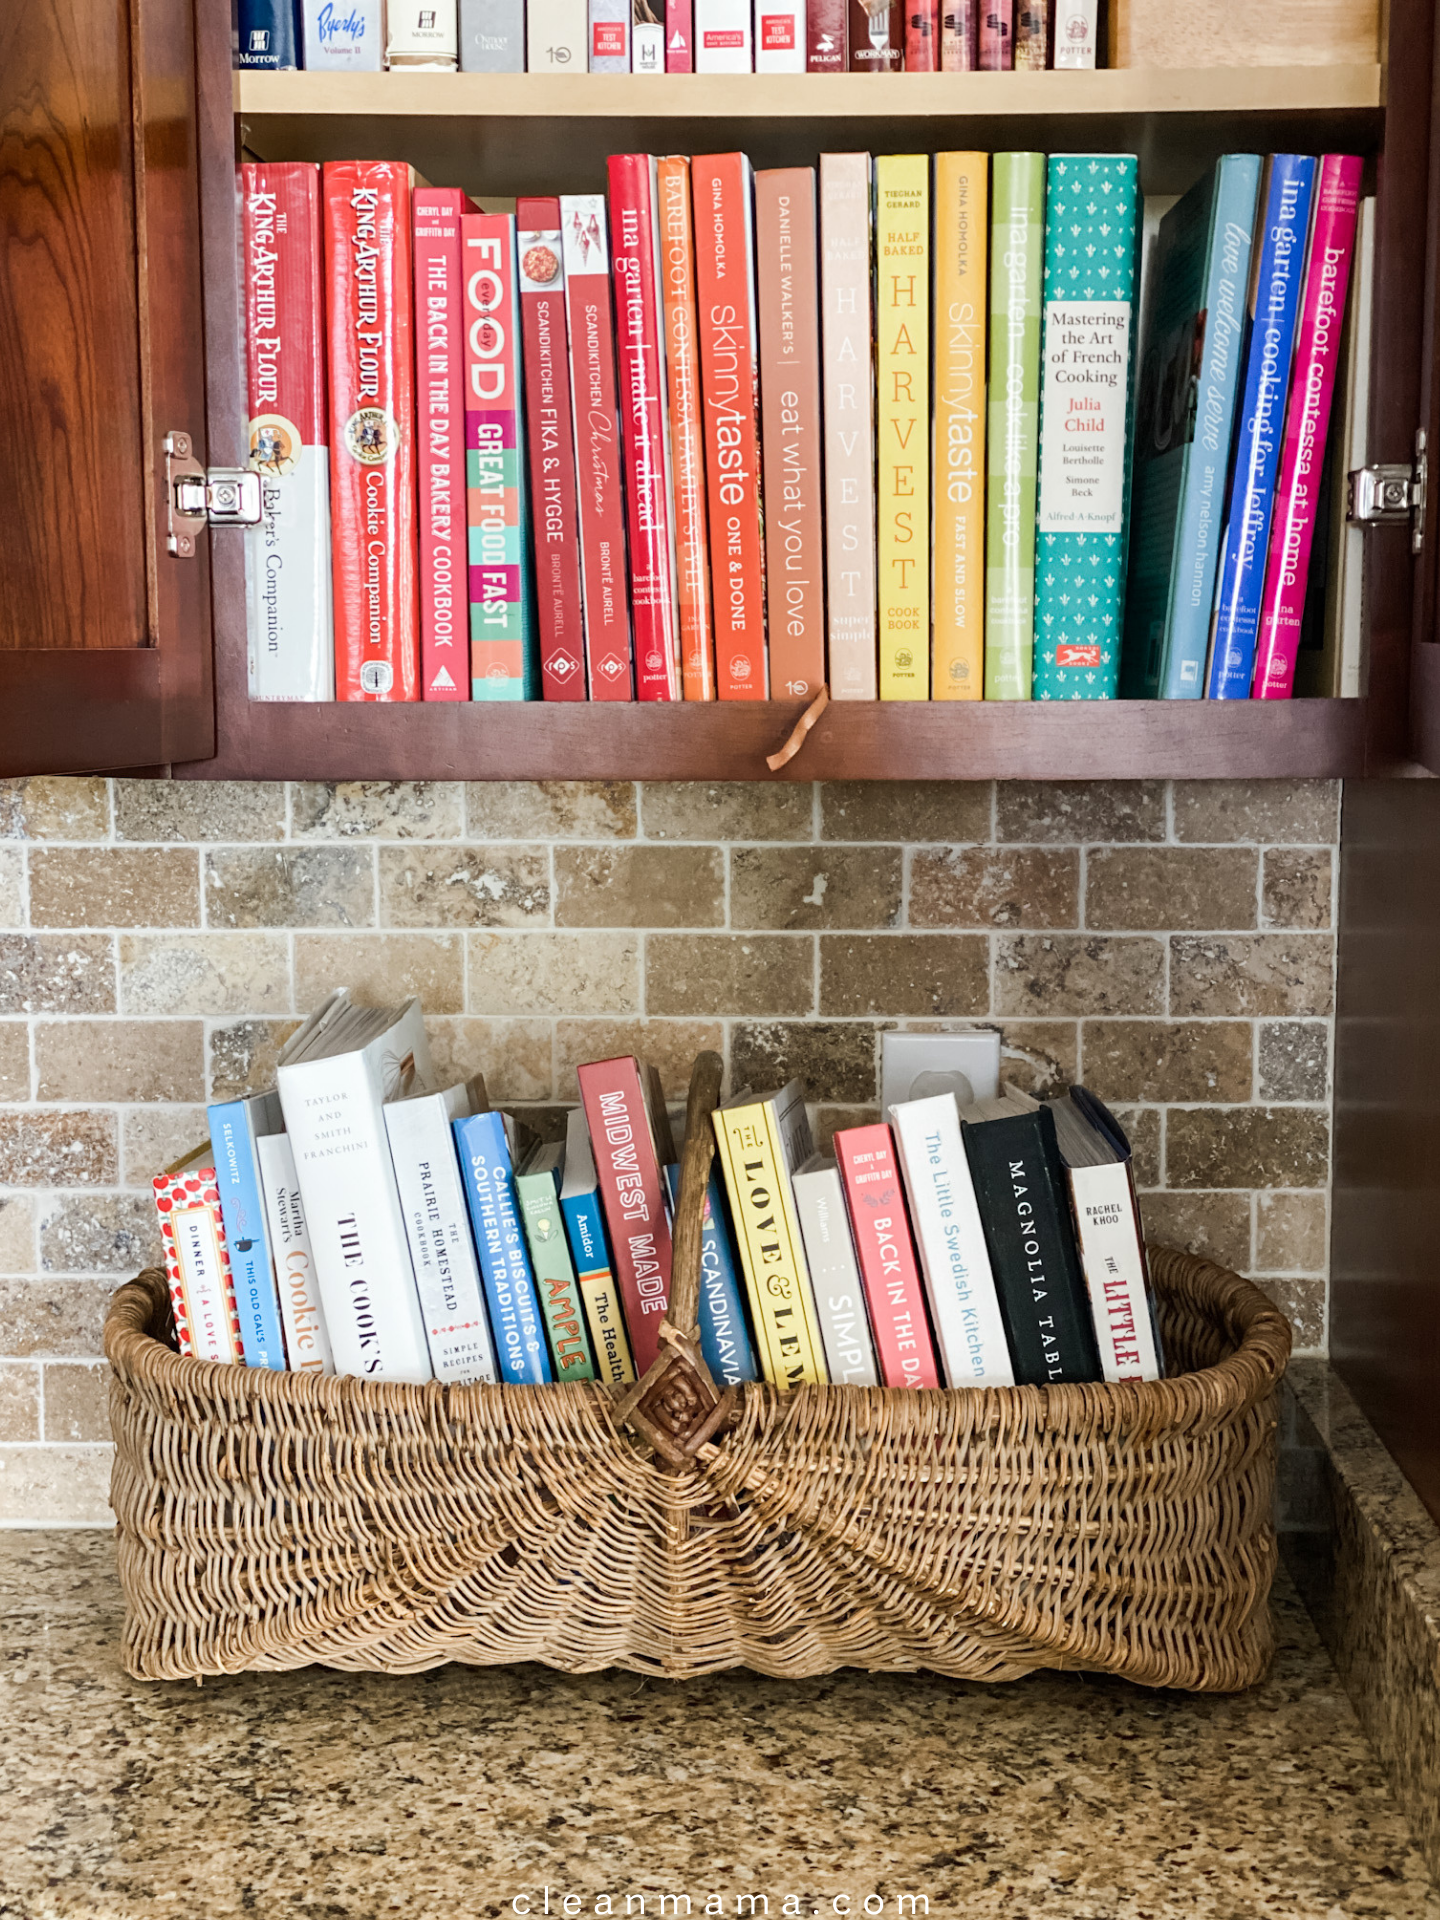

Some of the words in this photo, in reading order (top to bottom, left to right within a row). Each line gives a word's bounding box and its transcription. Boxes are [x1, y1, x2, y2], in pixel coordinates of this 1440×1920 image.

[317, 2, 365, 43] Byerly's
[706, 33, 741, 41] America's
[766, 34, 791, 44] KITCHEN
[239, 53, 280, 64] Morrow
[810, 54, 842, 62] PELICAN
[1060, 47, 1092, 55] POTTER
[350, 187, 378, 239] KING
[417, 207, 440, 216] CHERYL
[712, 177, 722, 210] GINA
[884, 190, 922, 198] TIEGHAN
[958, 175, 968, 207] GINA
[1279, 179, 1305, 220] ina
[249, 192, 276, 245] KING
[276, 212, 287, 234] THE
[415, 227, 442, 237] GRIFFITH
[622, 208, 646, 248] ina
[665, 175, 688, 301] BAREFOOT
[779, 196, 792, 272] DANIELLE
[888, 232, 920, 243] HALF
[1010, 207, 1034, 245] ina
[715, 214, 726, 279] HOMOLKA
[884, 245, 924, 256] BAKED
[958, 211, 968, 277] HOMOLKA
[1223, 222, 1252, 276] love
[251, 241, 278, 334] ARTHUR
[352, 236, 380, 329] ARTHUR
[427, 255, 447, 290] THE
[1268, 226, 1297, 312] garten
[615, 257, 646, 337] garten
[781, 276, 794, 354] WALKER'S
[1003, 252, 1031, 337] garten
[1311, 246, 1345, 355] barefoot
[427, 297, 448, 350] BACK
[466, 238, 505, 400] FOOD
[1052, 311, 1125, 330] Mastering
[1062, 331, 1085, 345] the
[1089, 331, 1114, 345] Art
[1211, 278, 1242, 383] welcome
[255, 336, 281, 407] FLOUR
[357, 331, 382, 403] FLOUR
[429, 355, 448, 373] IN
[537, 301, 554, 404] SCANDIKITCHEN
[585, 305, 602, 407] SCANDIKITCHEN
[671, 306, 694, 427] CONTESSA
[1051, 350, 1069, 363] of
[1073, 350, 1122, 364] French
[429, 378, 449, 415] THE
[1055, 370, 1118, 387] Cooking
[1247, 327, 1282, 433] cooking
[708, 305, 749, 505] Skinnytaste
[781, 391, 804, 435] eat
[941, 302, 981, 503] Skinnytaste
[1067, 397, 1101, 414] Julia
[1202, 385, 1226, 451] serve
[1298, 362, 1325, 475] contessa
[430, 419, 450, 460] DAY
[540, 408, 558, 451] FIKA
[836, 287, 861, 596] HARVEST
[890, 275, 917, 589] HARVEST
[1065, 418, 1105, 432] Child
[478, 423, 505, 498] GREAT
[543, 457, 560, 473] &
[588, 410, 612, 517] Christmas
[1062, 443, 1105, 453] Louisette
[1062, 456, 1104, 466] Bertholle
[1248, 438, 1273, 477] for
[782, 443, 807, 511] what
[1066, 475, 1100, 484] Simone
[1071, 488, 1093, 497] Beck
[1200, 466, 1215, 497] amy
[1292, 483, 1309, 510] at
[366, 471, 384, 536] Cookie
[430, 464, 452, 541] BAKERY
[544, 479, 563, 543] HYGGE
[1196, 499, 1212, 549] nelson
[481, 505, 506, 565] FOOD
[727, 517, 742, 555] ONE
[778, 521, 802, 571] you
[955, 516, 966, 549] FAST
[1231, 487, 1267, 570] Jeffrey
[728, 561, 742, 572] &
[955, 554, 966, 585] AND
[1283, 517, 1309, 587] home
[364, 540, 387, 645] Companion
[432, 545, 453, 648] COOKBOOK
[482, 573, 508, 628] FAST
[1191, 551, 1209, 607] hannon
[263, 554, 283, 652] Companion
[553, 598, 565, 637] AURELL
[602, 586, 615, 626] AURELL
[729, 578, 746, 631] DONE
[785, 580, 810, 636] love
[833, 615, 869, 626] super
[887, 608, 920, 617] COOK
[888, 620, 920, 629] BOOK
[955, 588, 966, 628] SLOW
[831, 629, 873, 642] simple
[643, 674, 667, 683] potter
[305, 1091, 349, 1107] TAYLOR
[318, 1110, 342, 1122] AND
[222, 1123, 240, 1184] SELKOWITZ
[304, 1140, 369, 1160] FRANCHINI
[314, 1126, 352, 1141] SMITH
[744, 1126, 754, 1148] THE
[853, 1153, 874, 1164] CHERYL
[855, 1172, 880, 1184] GRIFFITH
[275, 1187, 291, 1243] Stewart's
[289, 1191, 304, 1237] Martha
[600, 1090, 649, 1223] MIDWEST
[628, 1233, 668, 1314] MADE
[816, 1196, 830, 1243] Williams
[1086, 1204, 1122, 1217] RACHEL
[1093, 1214, 1119, 1226] KHOO
[337, 1212, 364, 1269] THE
[414, 1212, 431, 1267] COOKBOOK
[419, 1162, 440, 1221] PRAIRIE
[432, 1228, 457, 1312] HOMESTEAD
[448, 1223, 459, 1244] THE
[576, 1214, 594, 1259] Amidor
[744, 1160, 783, 1264] LOVE
[766, 1274, 792, 1300] &
[874, 1217, 899, 1275] BACK
[1009, 1160, 1048, 1302] MAGNOLIA
[245, 1261, 256, 1285] THIS
[471, 1155, 503, 1253] SOUTHERN
[491, 1258, 525, 1371] TRADITIONS
[493, 1166, 519, 1243] CALLIE'S
[509, 1250, 536, 1336] BISCUITS
[527, 1341, 540, 1353] &
[925, 1131, 940, 1166] The
[933, 1169, 954, 1218] Little
[944, 1224, 970, 1302] Swedish
[961, 1307, 986, 1377] Kitchen
[1105, 1256, 1119, 1274] THE
[189, 1225, 206, 1277] DINNER
[204, 1313, 217, 1347] LOVE
[249, 1288, 260, 1310] OLD
[285, 1250, 320, 1350] Cookie
[594, 1292, 609, 1324] The
[887, 1281, 907, 1305] IN
[253, 1313, 266, 1343] GAL'S
[349, 1279, 383, 1374] COOK'S
[543, 1278, 586, 1370] AMPLE
[893, 1312, 917, 1351] THE
[1103, 1279, 1140, 1366] LITTLE
[443, 1342, 478, 1356] SIMPLE
[443, 1353, 484, 1368] RECIPES
